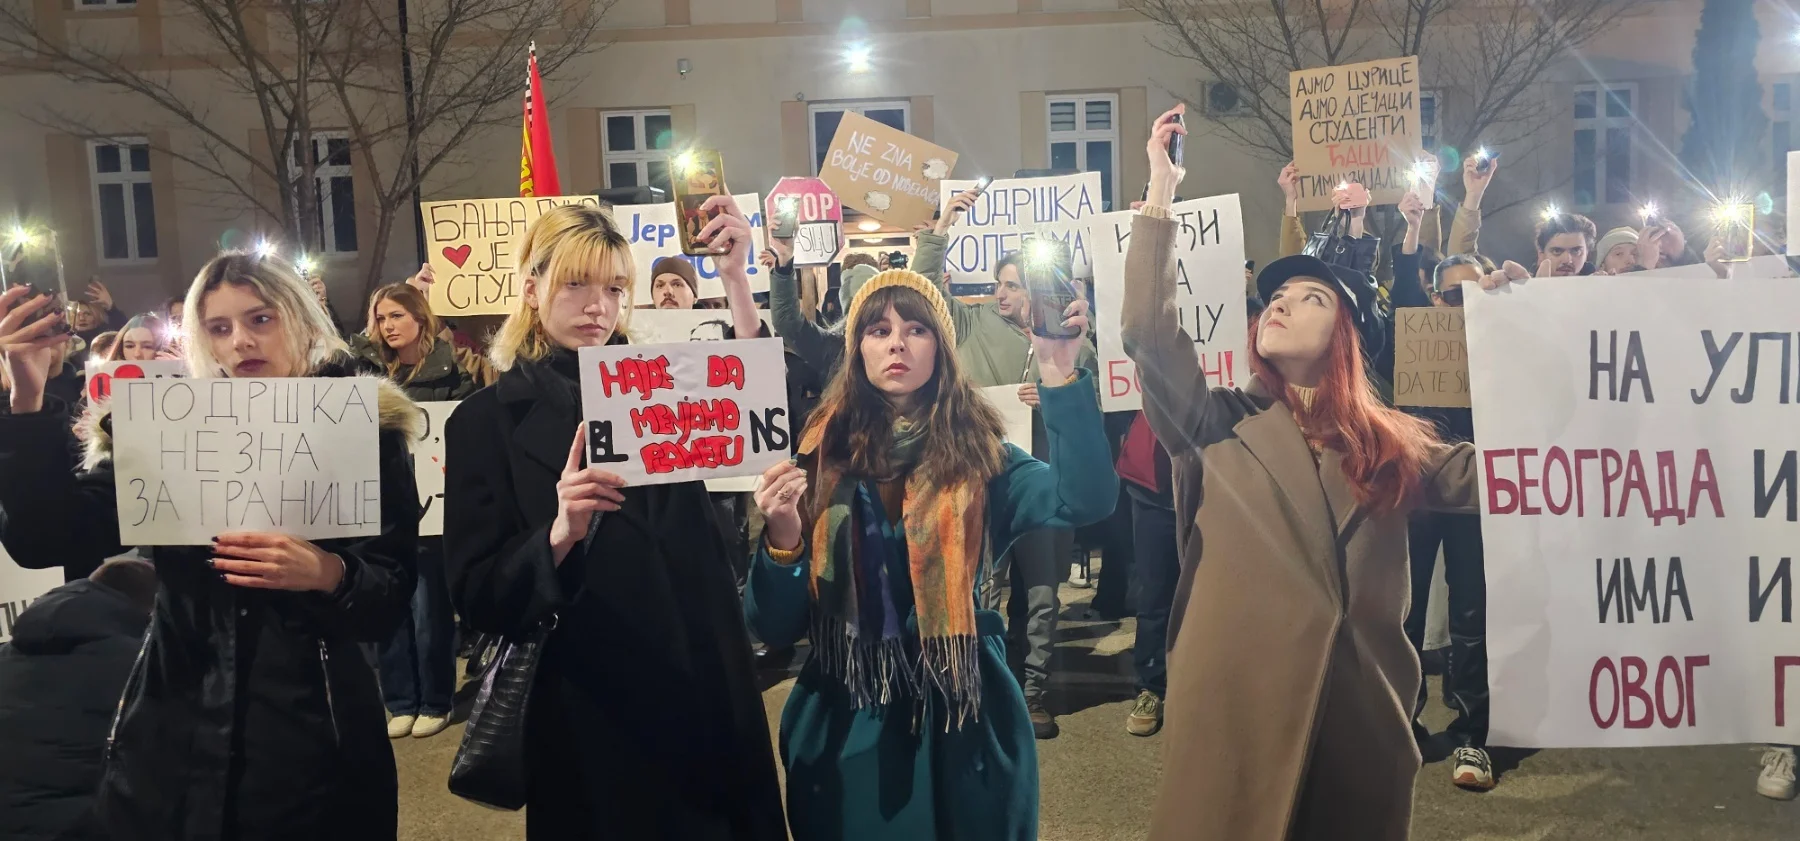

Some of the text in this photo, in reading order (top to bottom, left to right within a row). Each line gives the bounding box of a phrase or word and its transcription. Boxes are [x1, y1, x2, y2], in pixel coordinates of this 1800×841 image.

[1296, 62, 1412, 97] АЈМО ЦУРИЦЕ
[1300, 91, 1412, 120] АЈМО ДЈЕЧАЦИ
[1309, 115, 1405, 144] СТУДЕНТИ
[848, 131, 913, 171] NE ZNA
[873, 167, 891, 186] OD
[431, 201, 527, 242] БАЊА
[478, 241, 514, 272] ЈЕ
[707, 355, 745, 390] DA
[1397, 371, 1425, 395] DA
[1427, 371, 1449, 393] TE
[1590, 329, 1800, 404] НА УЛ
[128, 381, 373, 425] ПОДРШКА
[589, 420, 629, 463] BL
[750, 407, 790, 454] NS
[160, 430, 320, 475] НЕ ЗНА
[129, 478, 181, 526] ЗА
[200, 479, 379, 529] ГРАНИЦЕ
[1483, 445, 1726, 526] БЕОГРАДА
[1596, 556, 1793, 624] ИМА И
[1589, 655, 1710, 729] ОВОГ
